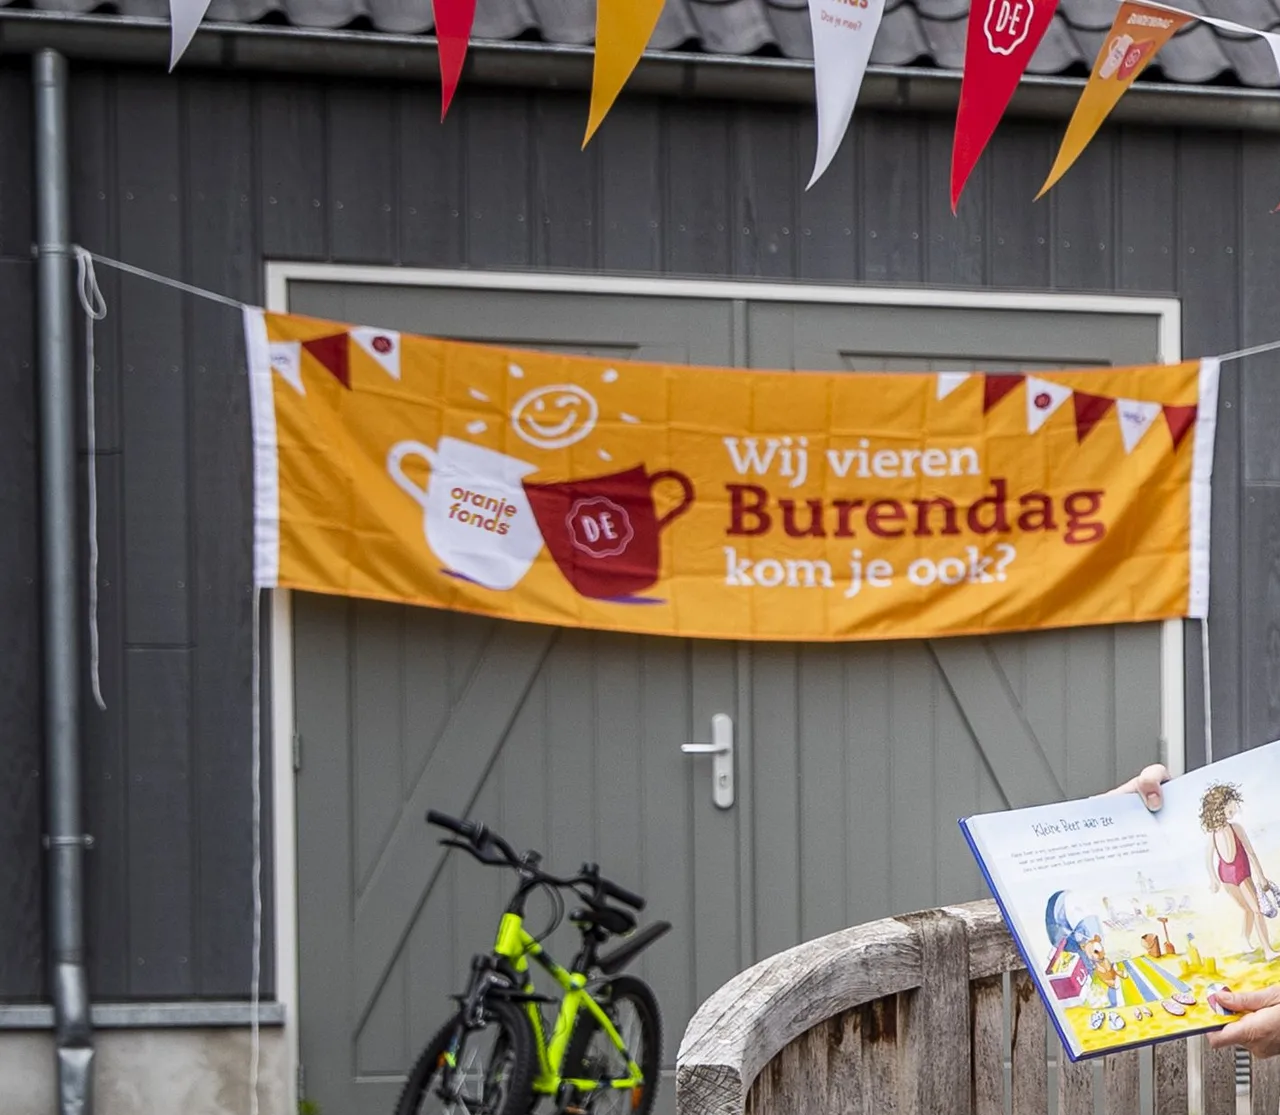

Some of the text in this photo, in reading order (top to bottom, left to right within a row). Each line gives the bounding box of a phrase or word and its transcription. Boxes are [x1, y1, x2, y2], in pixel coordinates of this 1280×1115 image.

[821, 10, 834, 23] Doe
[723, 437, 980, 488] Wij vieren
[448, 502, 511, 536] fonds
[450, 487, 518, 522] oranje
[724, 478, 1107, 546] Burendag
[723, 543, 1017, 598] kom je ook?
[1031, 816, 1114, 837] Kleine Beer aan zee
